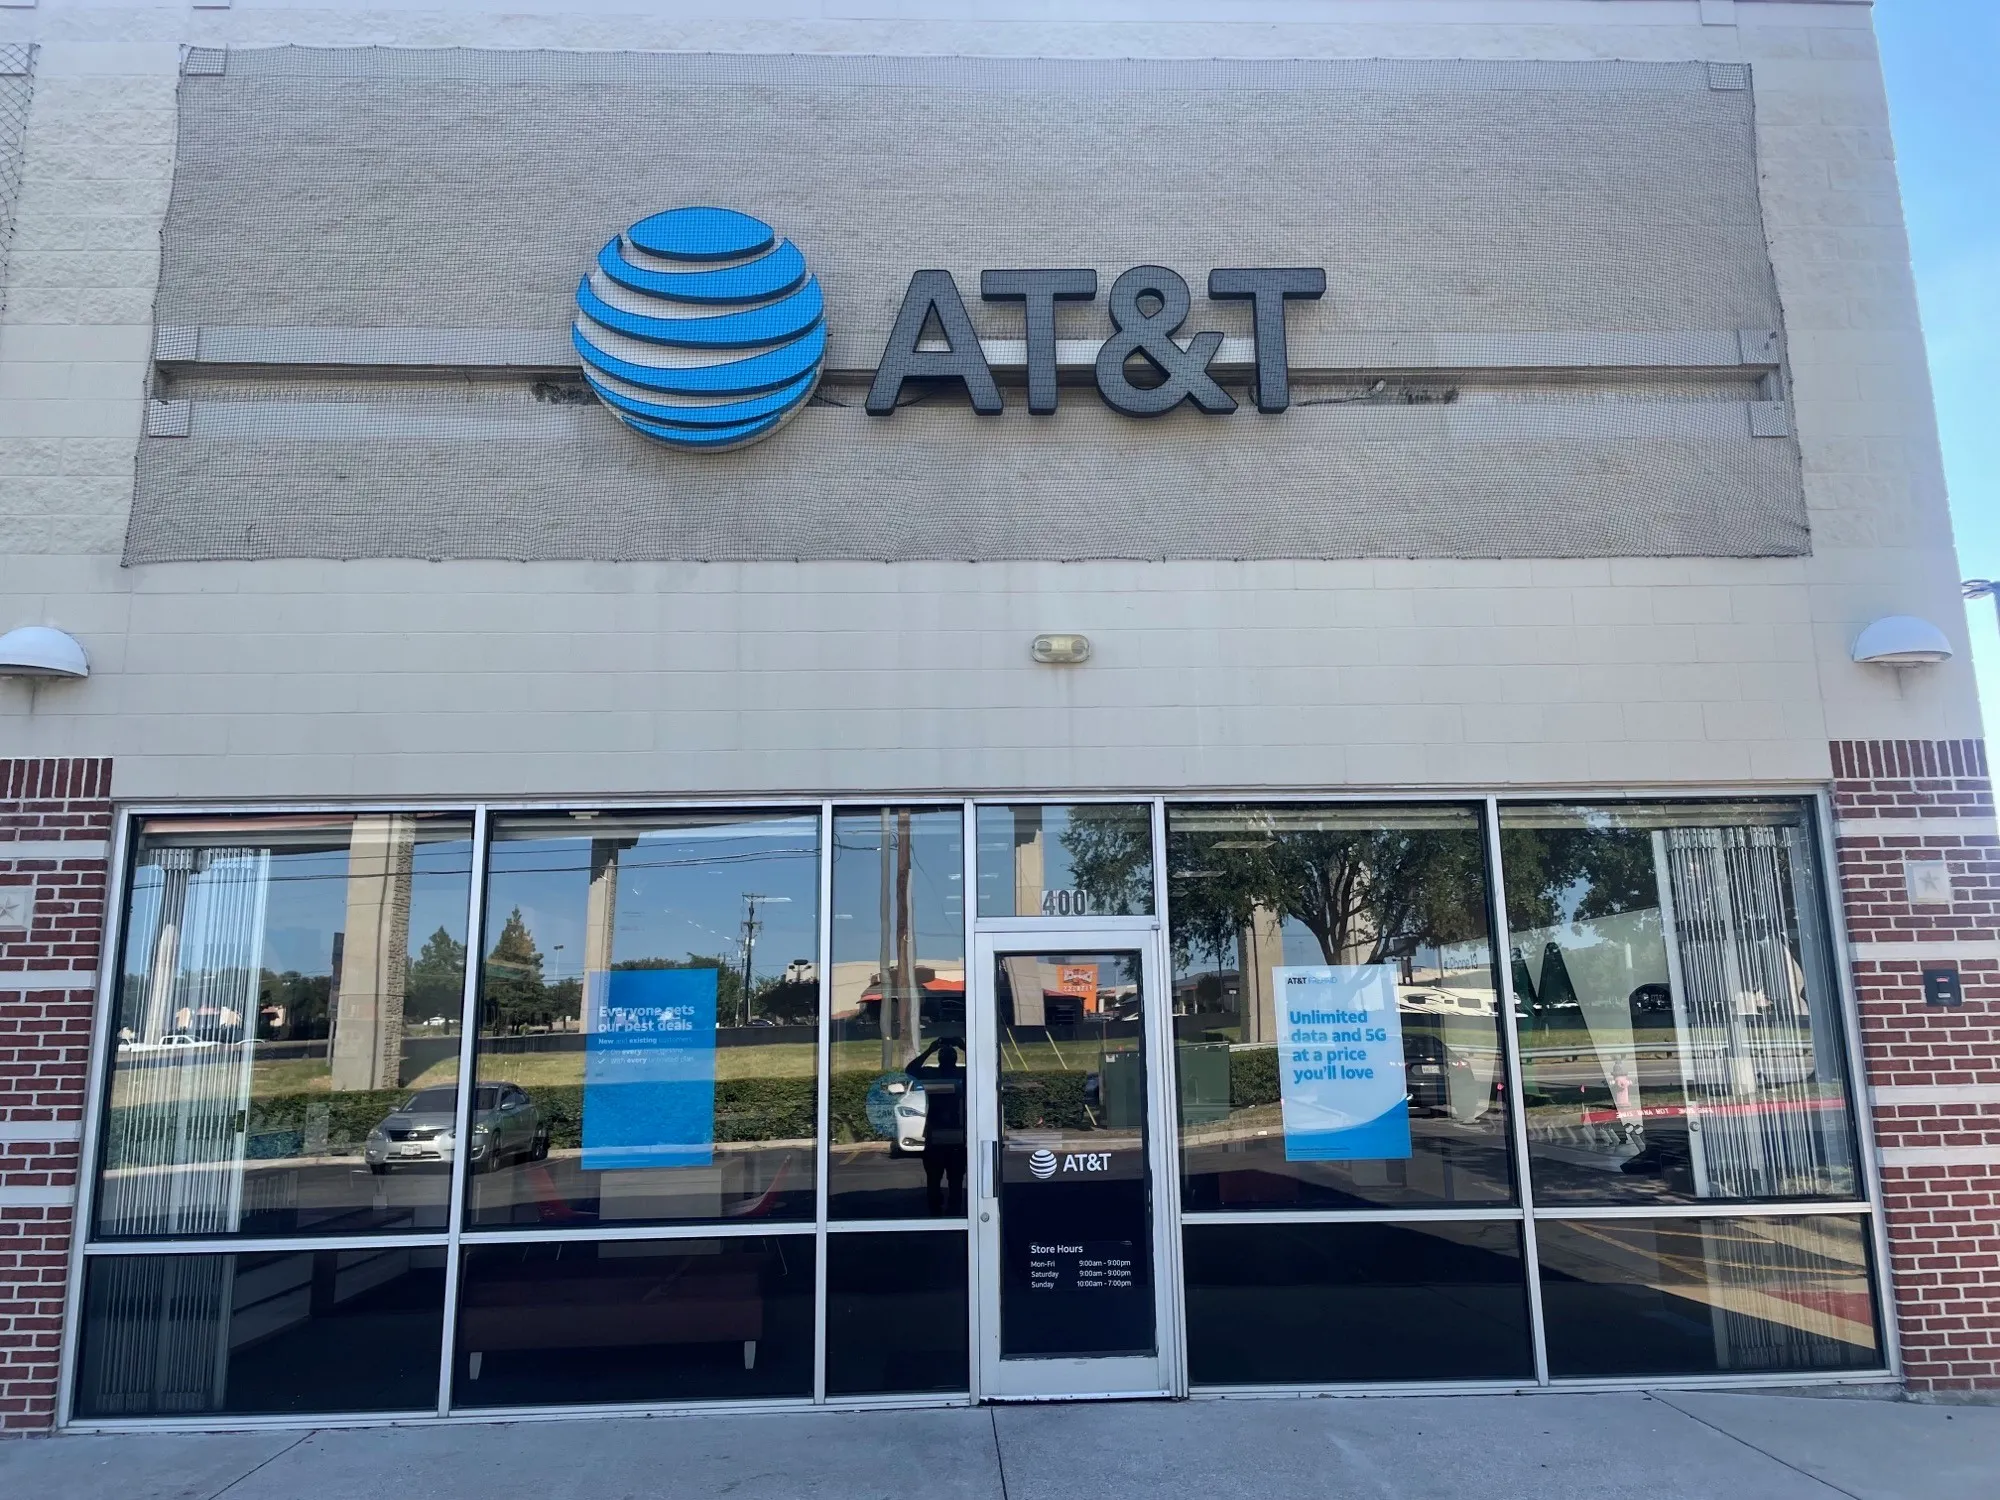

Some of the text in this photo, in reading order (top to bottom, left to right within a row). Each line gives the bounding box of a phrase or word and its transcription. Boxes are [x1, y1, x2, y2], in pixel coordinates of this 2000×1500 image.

[865, 264, 1327, 419] AT&T
[1042, 889, 1086, 916] 400
[1287, 977, 1307, 985] AT&T
[599, 1004, 695, 1020] Everyone gets
[1289, 1009, 1368, 1024] Unlimited
[598, 1019, 693, 1033] our best deals
[629, 1037, 657, 1045] existing
[1291, 1028, 1387, 1042] data and 5G
[622, 1049, 643, 1057] every
[1292, 1047, 1367, 1064] at a price
[627, 1057, 648, 1065] every
[1293, 1064, 1374, 1084] you'll love
[1062, 1153, 1111, 1172] AT&T
[1031, 1245, 1083, 1254] Store Hours
[1030, 1260, 1056, 1268] Mon-Fri
[1107, 1260, 1131, 1268] 9:00pm
[1031, 1271, 1059, 1279] Saturday
[1107, 1270, 1131, 1278] 9:00pm
[1031, 1281, 1055, 1289] Sunday
[1077, 1280, 1102, 1288] 10:00am
[1108, 1280, 1131, 1288] 7:00pm
